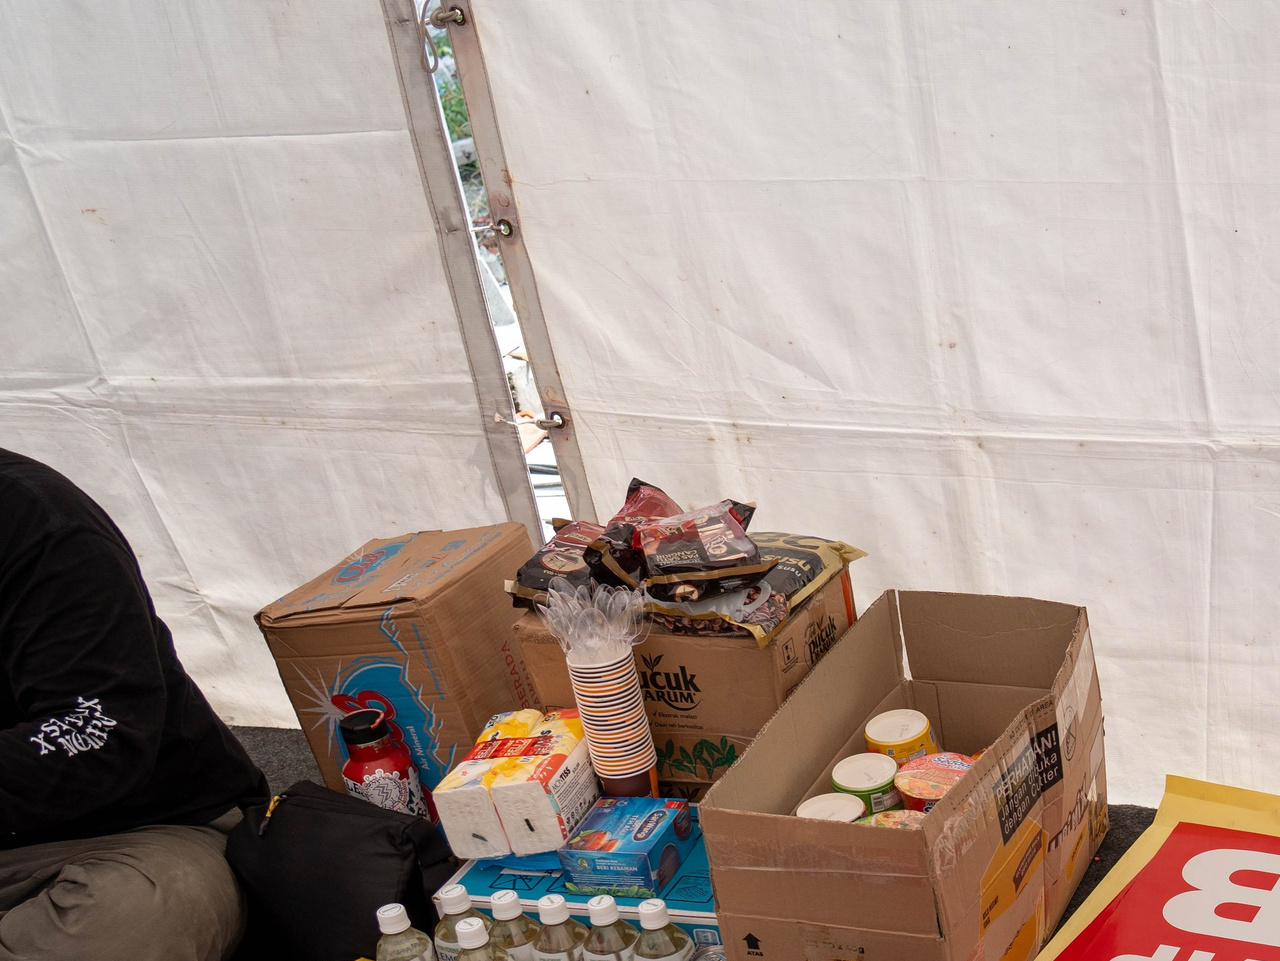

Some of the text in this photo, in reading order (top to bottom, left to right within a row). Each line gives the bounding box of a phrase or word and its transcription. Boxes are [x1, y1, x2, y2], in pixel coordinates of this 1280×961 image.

[640, 665, 702, 692] ucuk
[644, 690, 696, 704] ARUM
[1035, 700, 1054, 713] AREA
[406, 725, 431, 771] Air Mineral
[1001, 780, 1027, 821] Jangan
[1004, 795, 1031, 835] dengan
